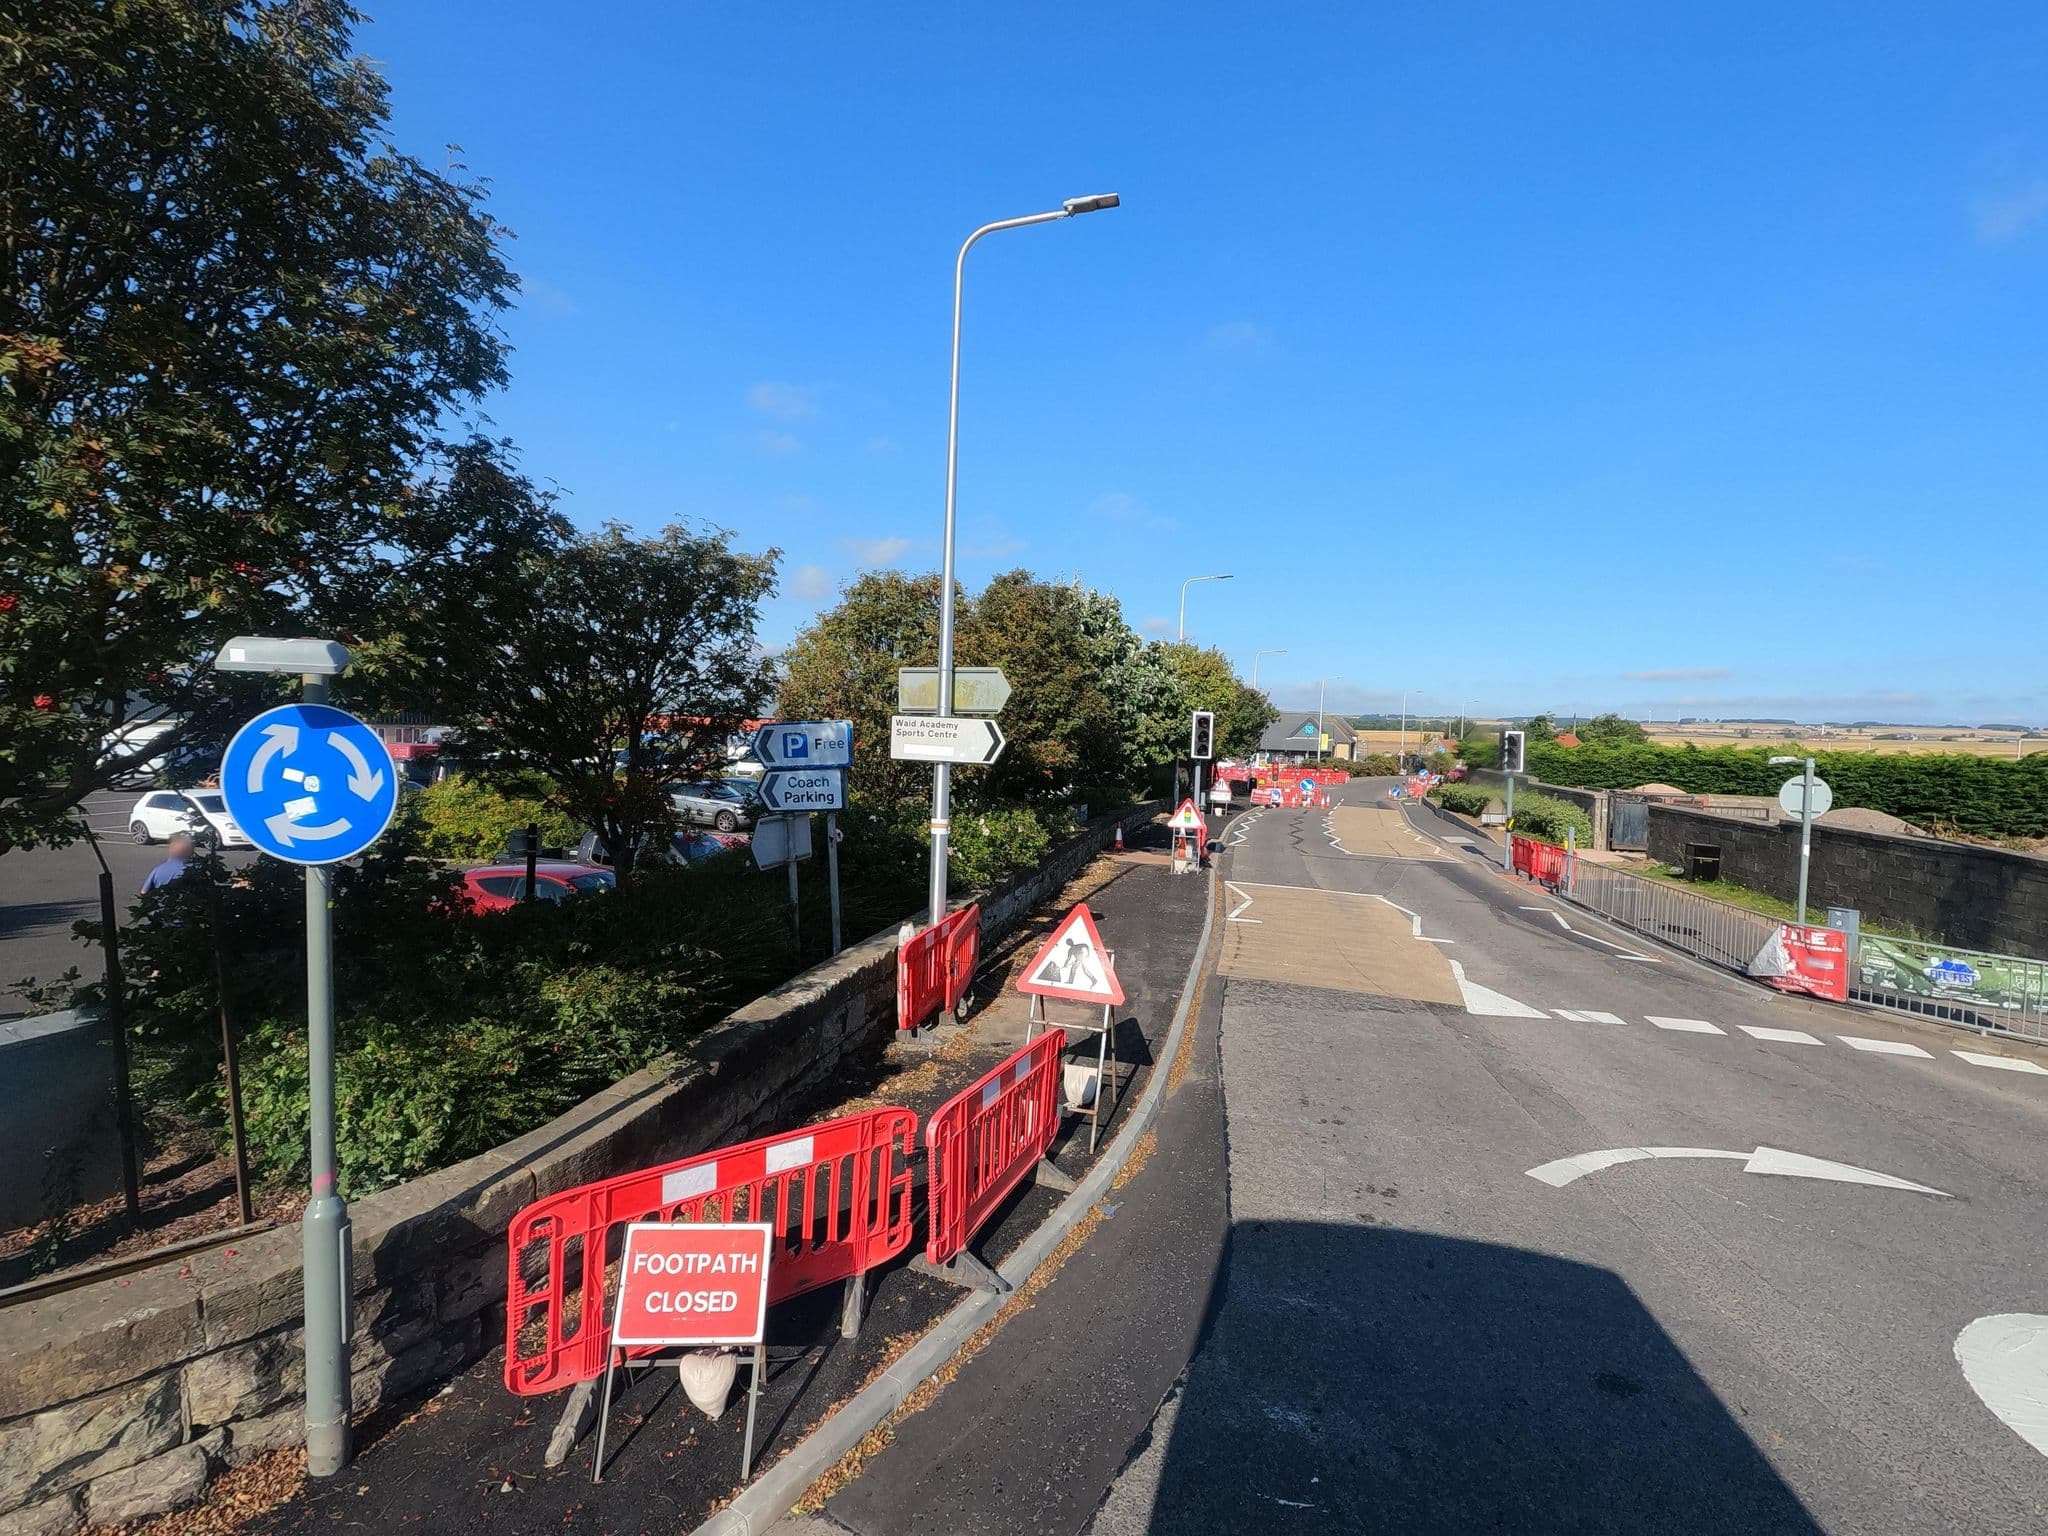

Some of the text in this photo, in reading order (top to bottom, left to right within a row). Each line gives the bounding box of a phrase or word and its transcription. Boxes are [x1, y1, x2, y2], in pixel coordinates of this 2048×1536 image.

[895, 719, 959, 730] Waid Academy
[895, 729, 958, 739] Sports Centre
[786, 734, 845, 757] P Free
[787, 776, 830, 788] Coach
[784, 790, 835, 805] Parking
[1952, 972, 1977, 985] FEST
[632, 1252, 758, 1275] FOOTPATH
[644, 1290, 738, 1314] CLOSED
